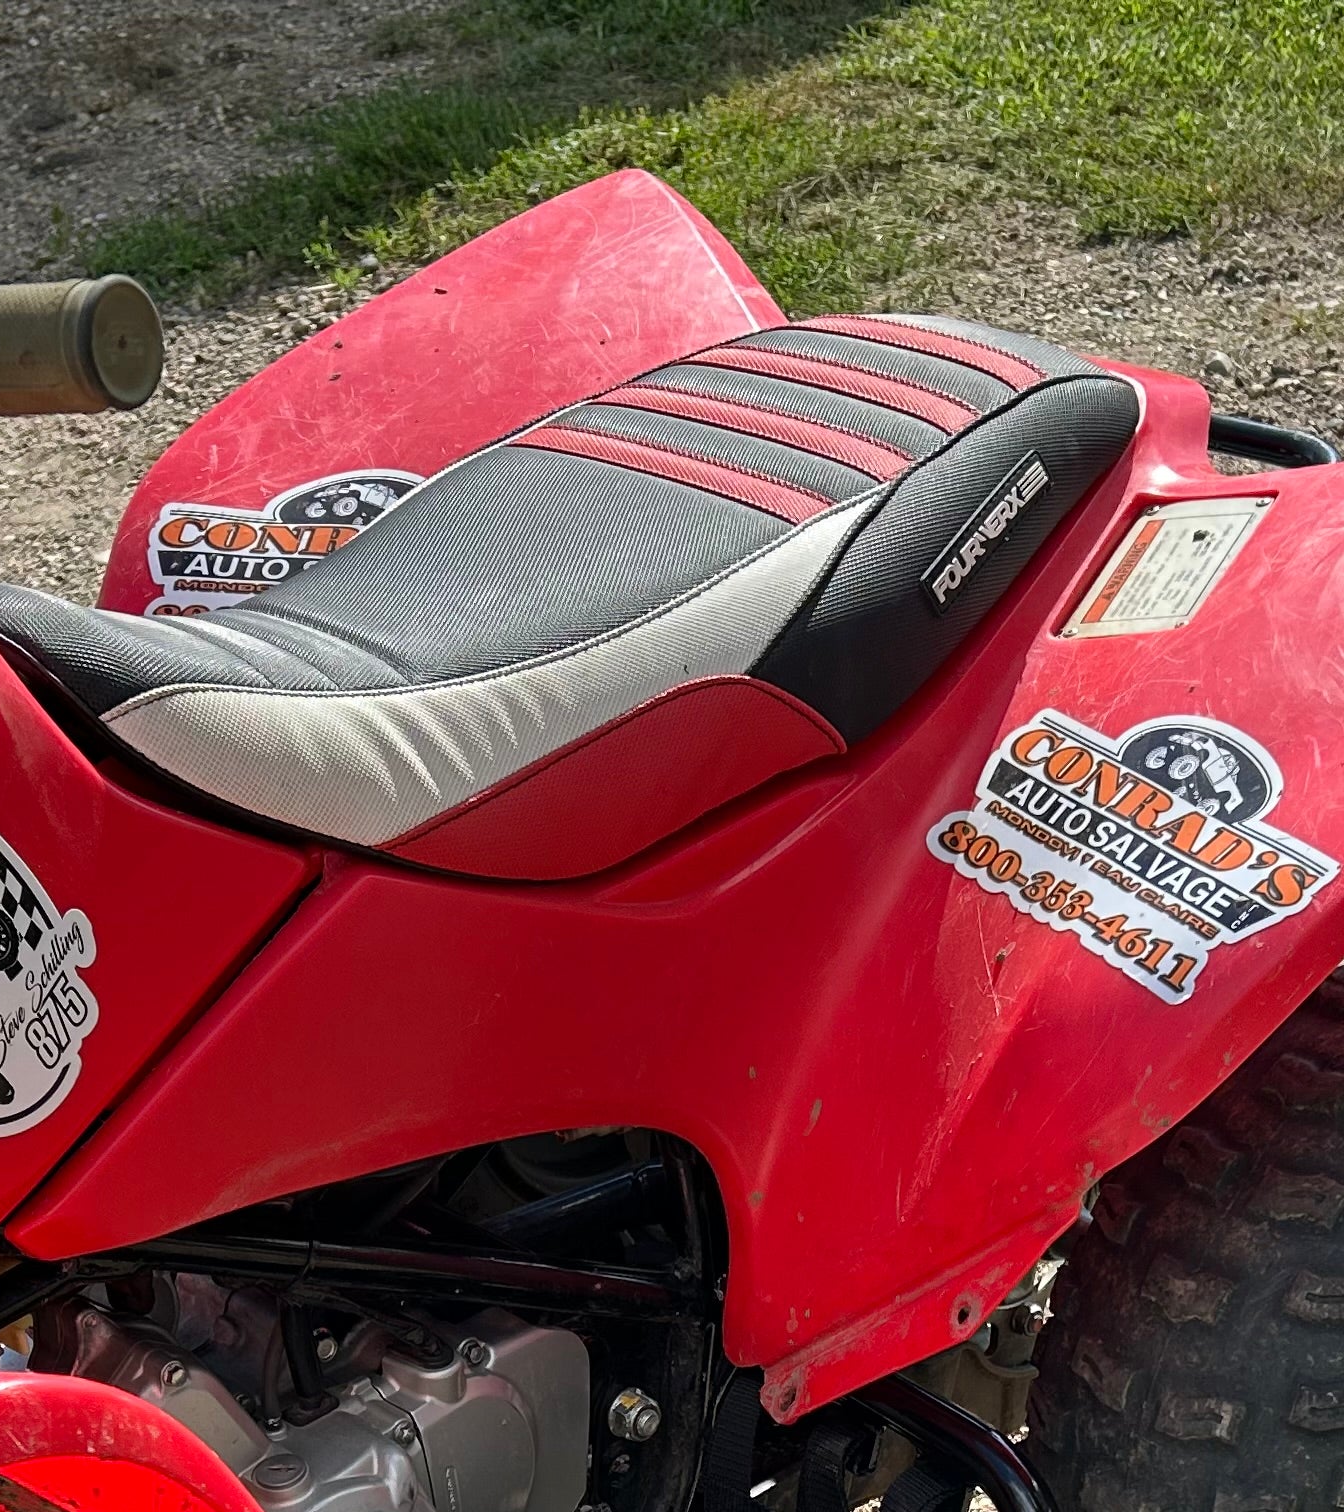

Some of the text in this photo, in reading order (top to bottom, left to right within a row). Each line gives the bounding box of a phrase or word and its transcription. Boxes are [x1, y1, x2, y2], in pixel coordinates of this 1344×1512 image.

[184, 553, 290, 580] AUTO
[1003, 777, 1090, 836] AUTO
[1087, 820, 1242, 919] SALVAGE
[1007, 727, 1319, 907] CONRAD'S
[940, 818, 1197, 994] 800-353-4611
[1090, 860, 1142, 895] EAU
[1138, 888, 1221, 940] CLAIRE
[24, 920, 85, 1013] Schilling
[25, 970, 89, 1070] 875
